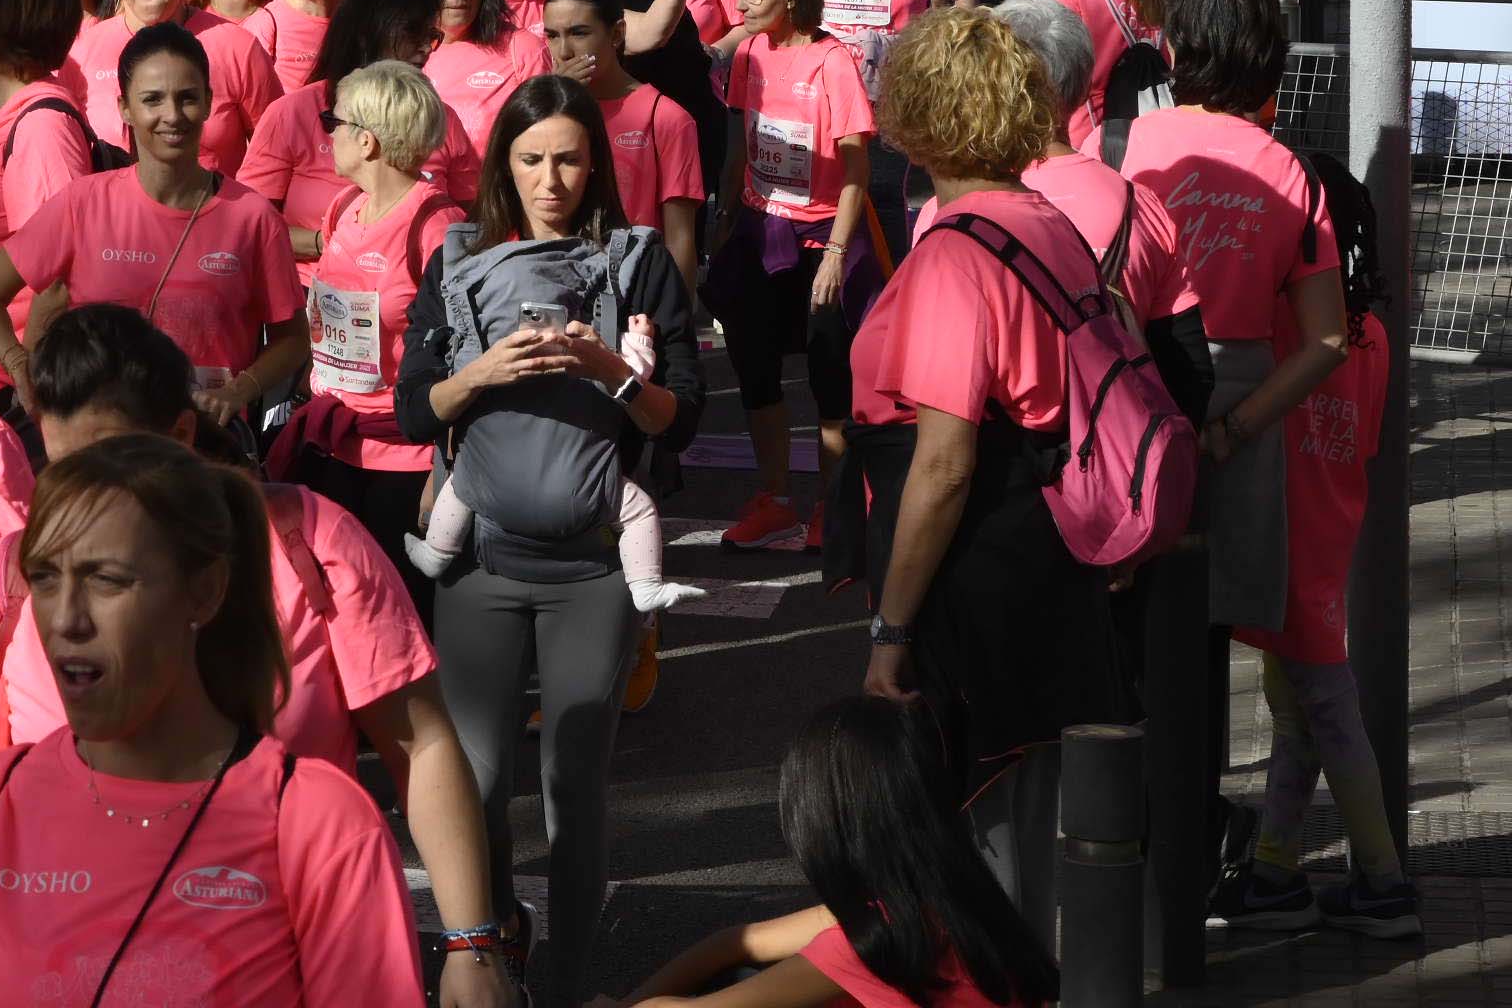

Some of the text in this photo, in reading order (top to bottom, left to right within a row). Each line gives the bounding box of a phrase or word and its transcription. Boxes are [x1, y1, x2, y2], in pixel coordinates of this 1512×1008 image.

[759, 147, 782, 164] 016
[1164, 171, 1269, 214] Carrera
[1178, 211, 1246, 271] Mujer
[102, 248, 156, 264] OYSHO
[325, 324, 347, 344] 016
[181, 880, 260, 902] ASTURIANA
